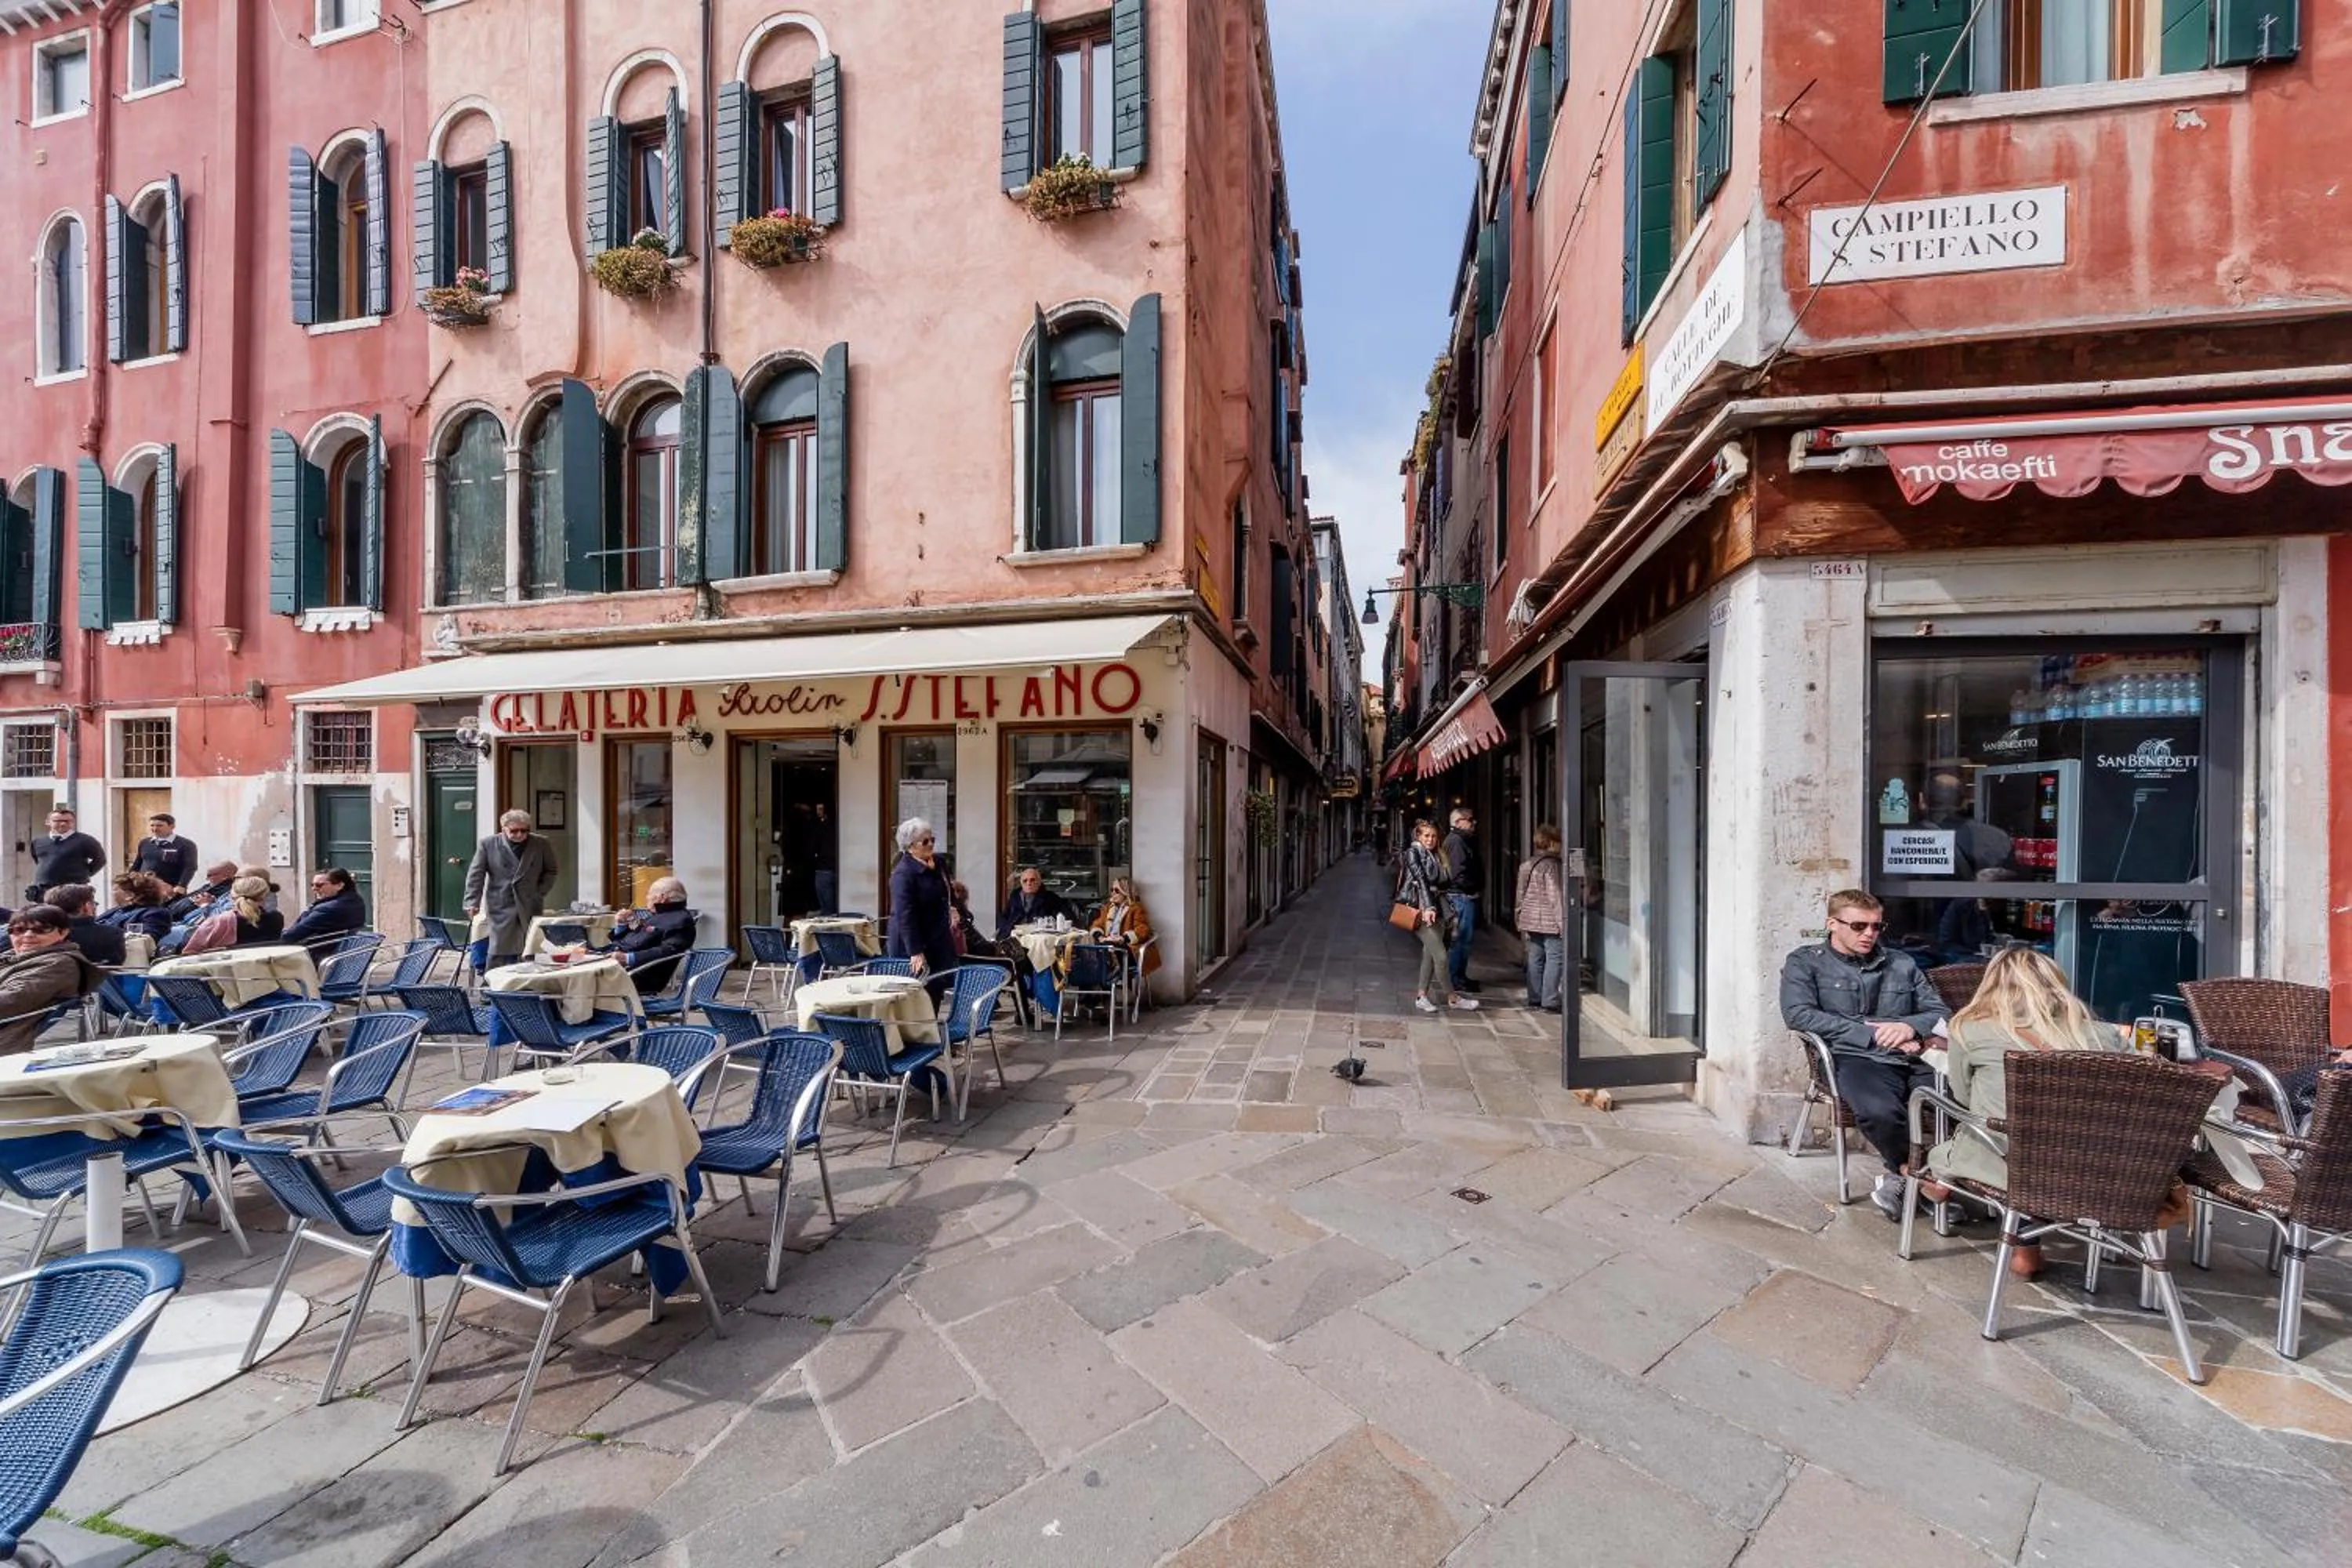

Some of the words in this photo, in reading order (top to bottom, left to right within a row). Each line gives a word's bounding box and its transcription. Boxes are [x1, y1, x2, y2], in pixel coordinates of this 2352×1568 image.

[1831, 199, 2039, 238] CAMPIELLO
[1869, 229, 2039, 264] STEFANO
[1938, 439, 2009, 460] caffe
[1900, 454, 2057, 483] mokaefti
[490, 686, 697, 732] GELATERIA
[718, 682, 845, 717] Paolin
